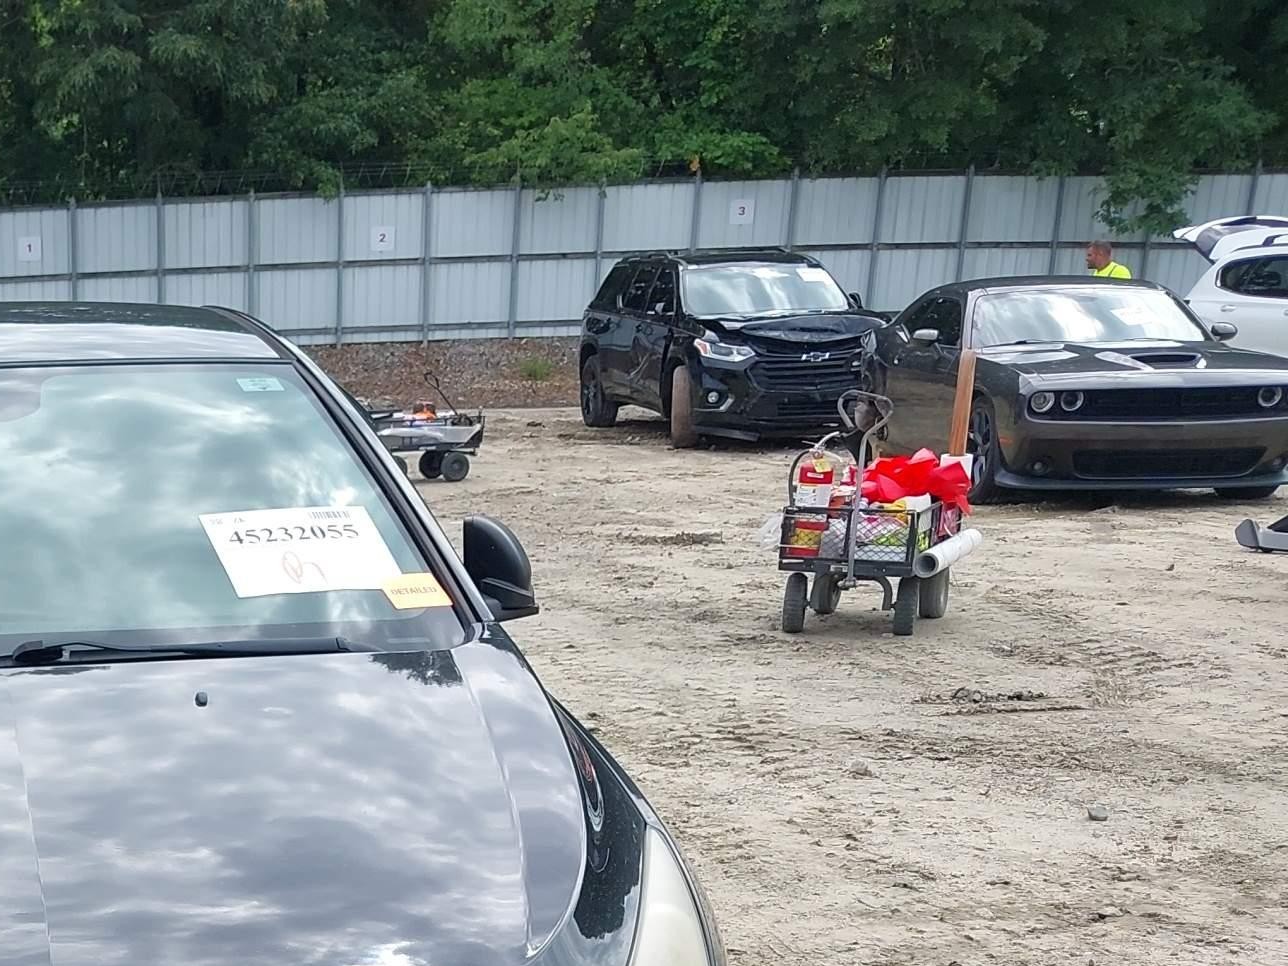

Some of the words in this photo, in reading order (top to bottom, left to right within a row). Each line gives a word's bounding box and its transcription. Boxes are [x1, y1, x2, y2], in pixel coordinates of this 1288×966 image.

[738, 206, 746, 216] 3
[379, 233, 387, 243] 2
[228, 524, 360, 545] 45232055
